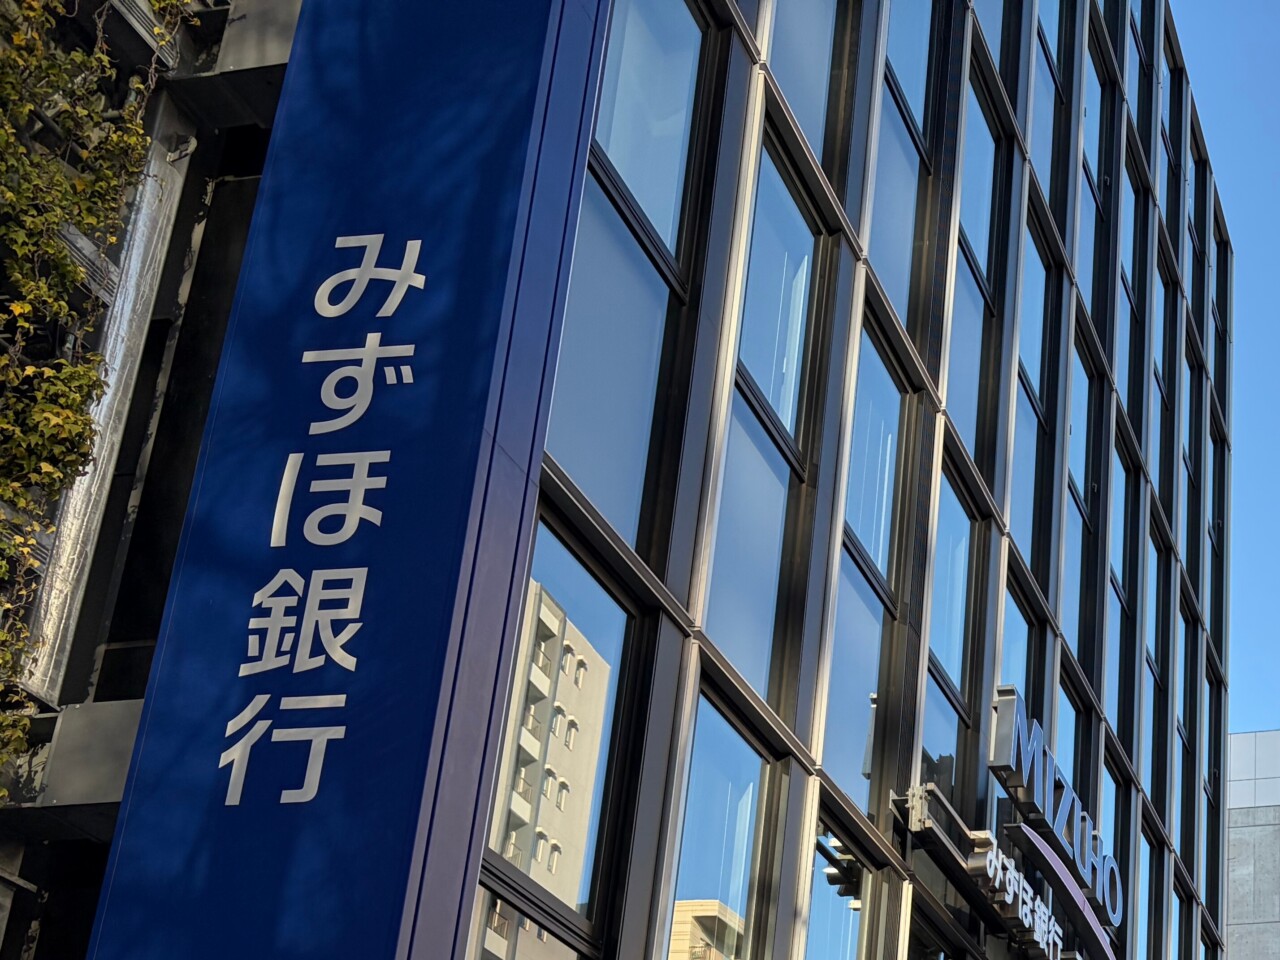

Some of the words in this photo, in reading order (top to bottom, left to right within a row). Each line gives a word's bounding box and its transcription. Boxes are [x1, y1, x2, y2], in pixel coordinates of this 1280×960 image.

[218, 233, 426, 806] みずほ銀行
[1006, 686, 1123, 927] MIZUHO
